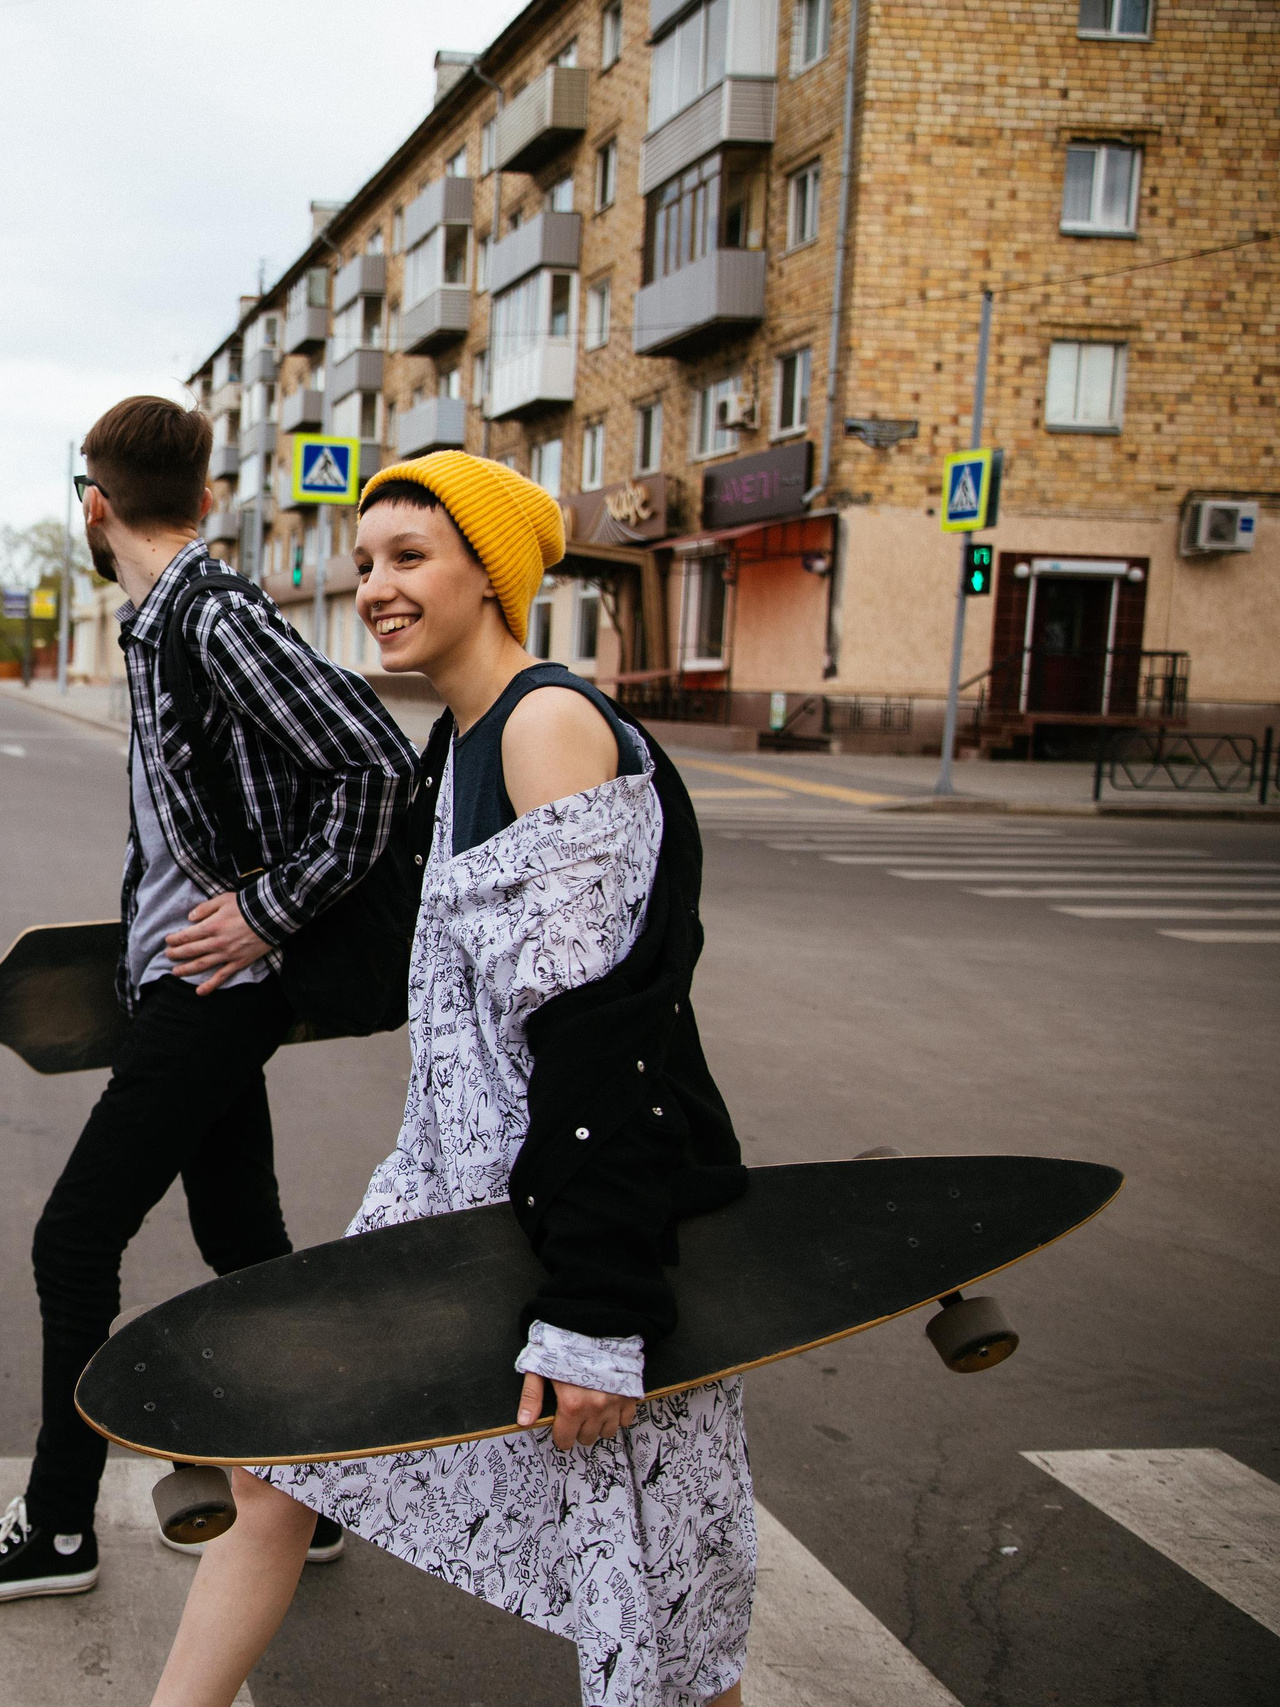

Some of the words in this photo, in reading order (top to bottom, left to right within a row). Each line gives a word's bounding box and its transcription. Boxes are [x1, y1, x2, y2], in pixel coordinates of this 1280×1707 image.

[340, 1461, 369, 1479] DINOSAUR
[483, 1444, 509, 1513] TOROSAURUS
[522, 1453, 544, 1505] STOMP
[677, 1463, 704, 1497] STOMP
[426, 1492, 453, 1529] STOMP
[604, 1566, 636, 1645] TOROSAURUS
